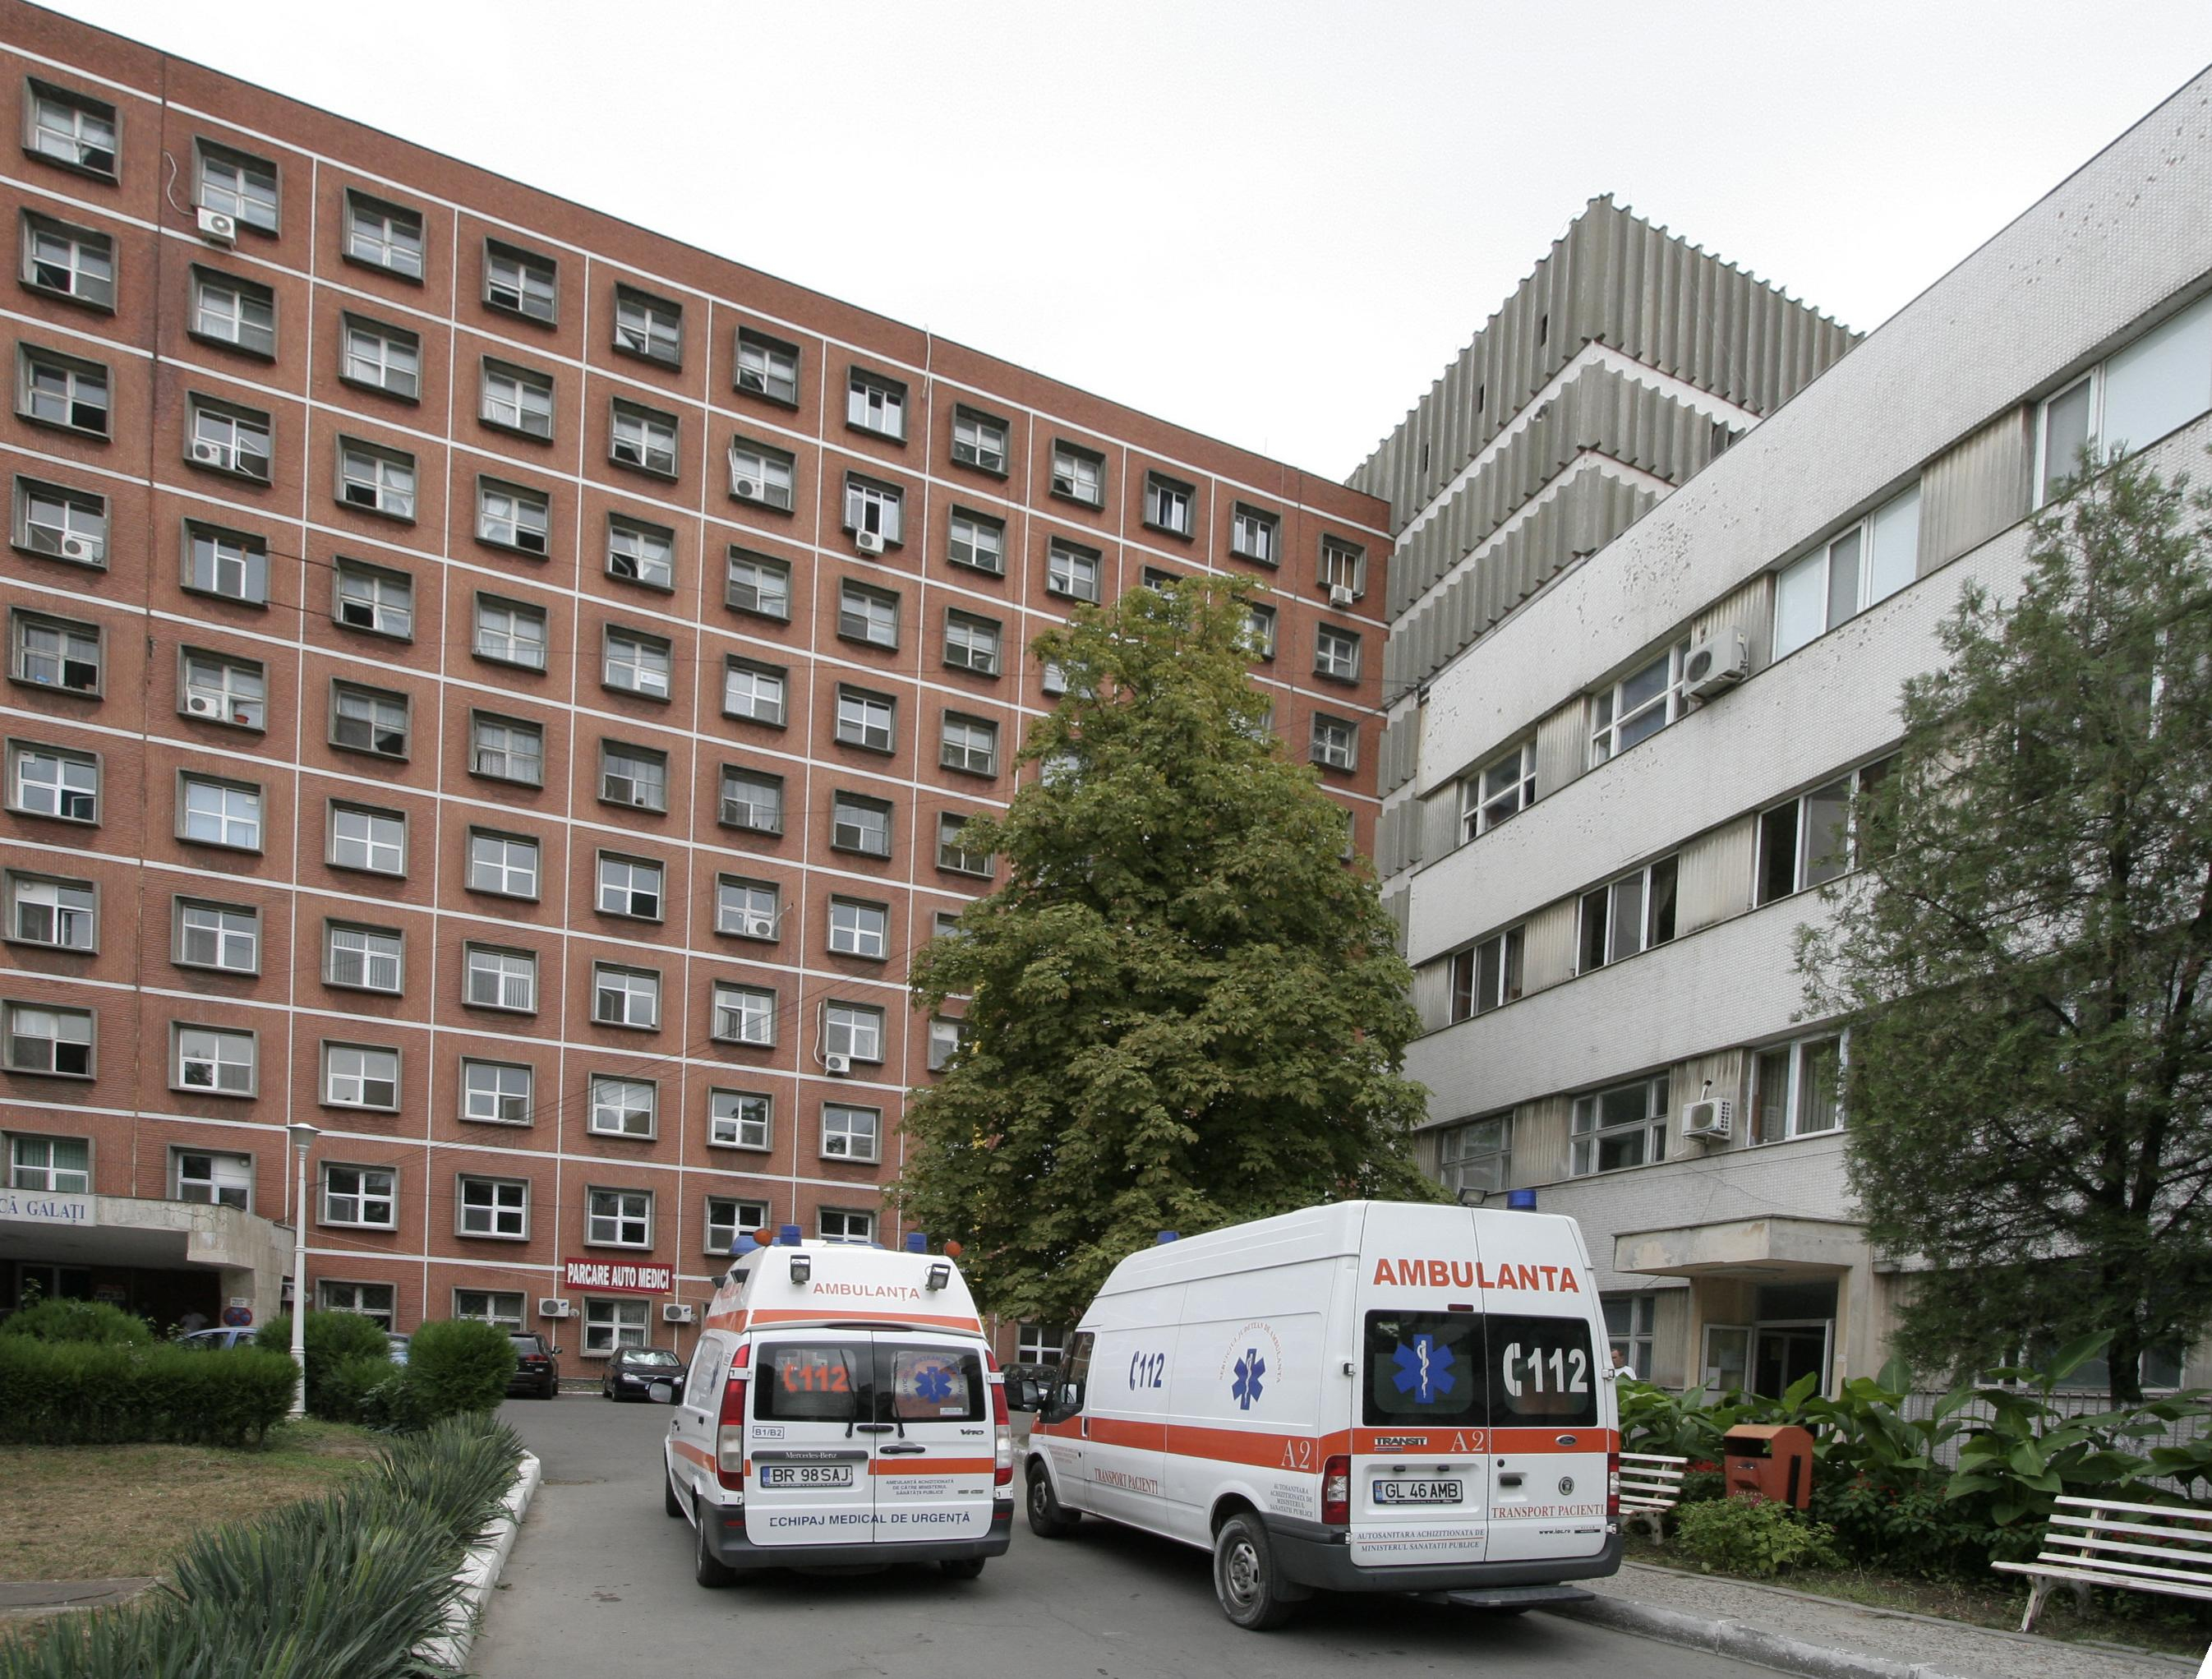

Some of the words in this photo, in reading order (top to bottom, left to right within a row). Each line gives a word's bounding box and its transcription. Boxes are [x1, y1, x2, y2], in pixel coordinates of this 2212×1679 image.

[27, 1201, 85, 1224] GALAȚI
[567, 1263, 610, 1286] PARCARE
[611, 1266, 636, 1288] AUTO
[638, 1267, 670, 1289] MEDICI
[1373, 1258, 1579, 1293] AMBULANTA
[799, 1365, 850, 1391] 112
[1139, 1352, 1165, 1388] 112
[1528, 1347, 1588, 1393] 112
[755, 1428, 782, 1437] B1/B2
[772, 1469, 795, 1483] BR
[801, 1468, 819, 1482] 98
[821, 1468, 848, 1482] SAJ
[1094, 1468, 1127, 1488] TRANSPORT
[1128, 1474, 1158, 1495] PACIENTI
[1385, 1483, 1404, 1498] GL
[1410, 1483, 1426, 1497] 46
[1430, 1483, 1458, 1497] AMB
[770, 1515, 825, 1527] ECHIPAJ
[829, 1514, 887, 1524] MEDICAL
[891, 1514, 908, 1524] DE
[1491, 1506, 1555, 1519] TRANSPORT
[1558, 1504, 1605, 1516] PACIENTI
[1357, 1532, 1415, 1540] AUTOSANITARA
[1416, 1530, 1473, 1538] ACHIZITIONATA
[1361, 1543, 1408, 1552] MINISTERUL
[1409, 1543, 1448, 1551] SANATATII
[1448, 1541, 1479, 1549] PUBLICE
